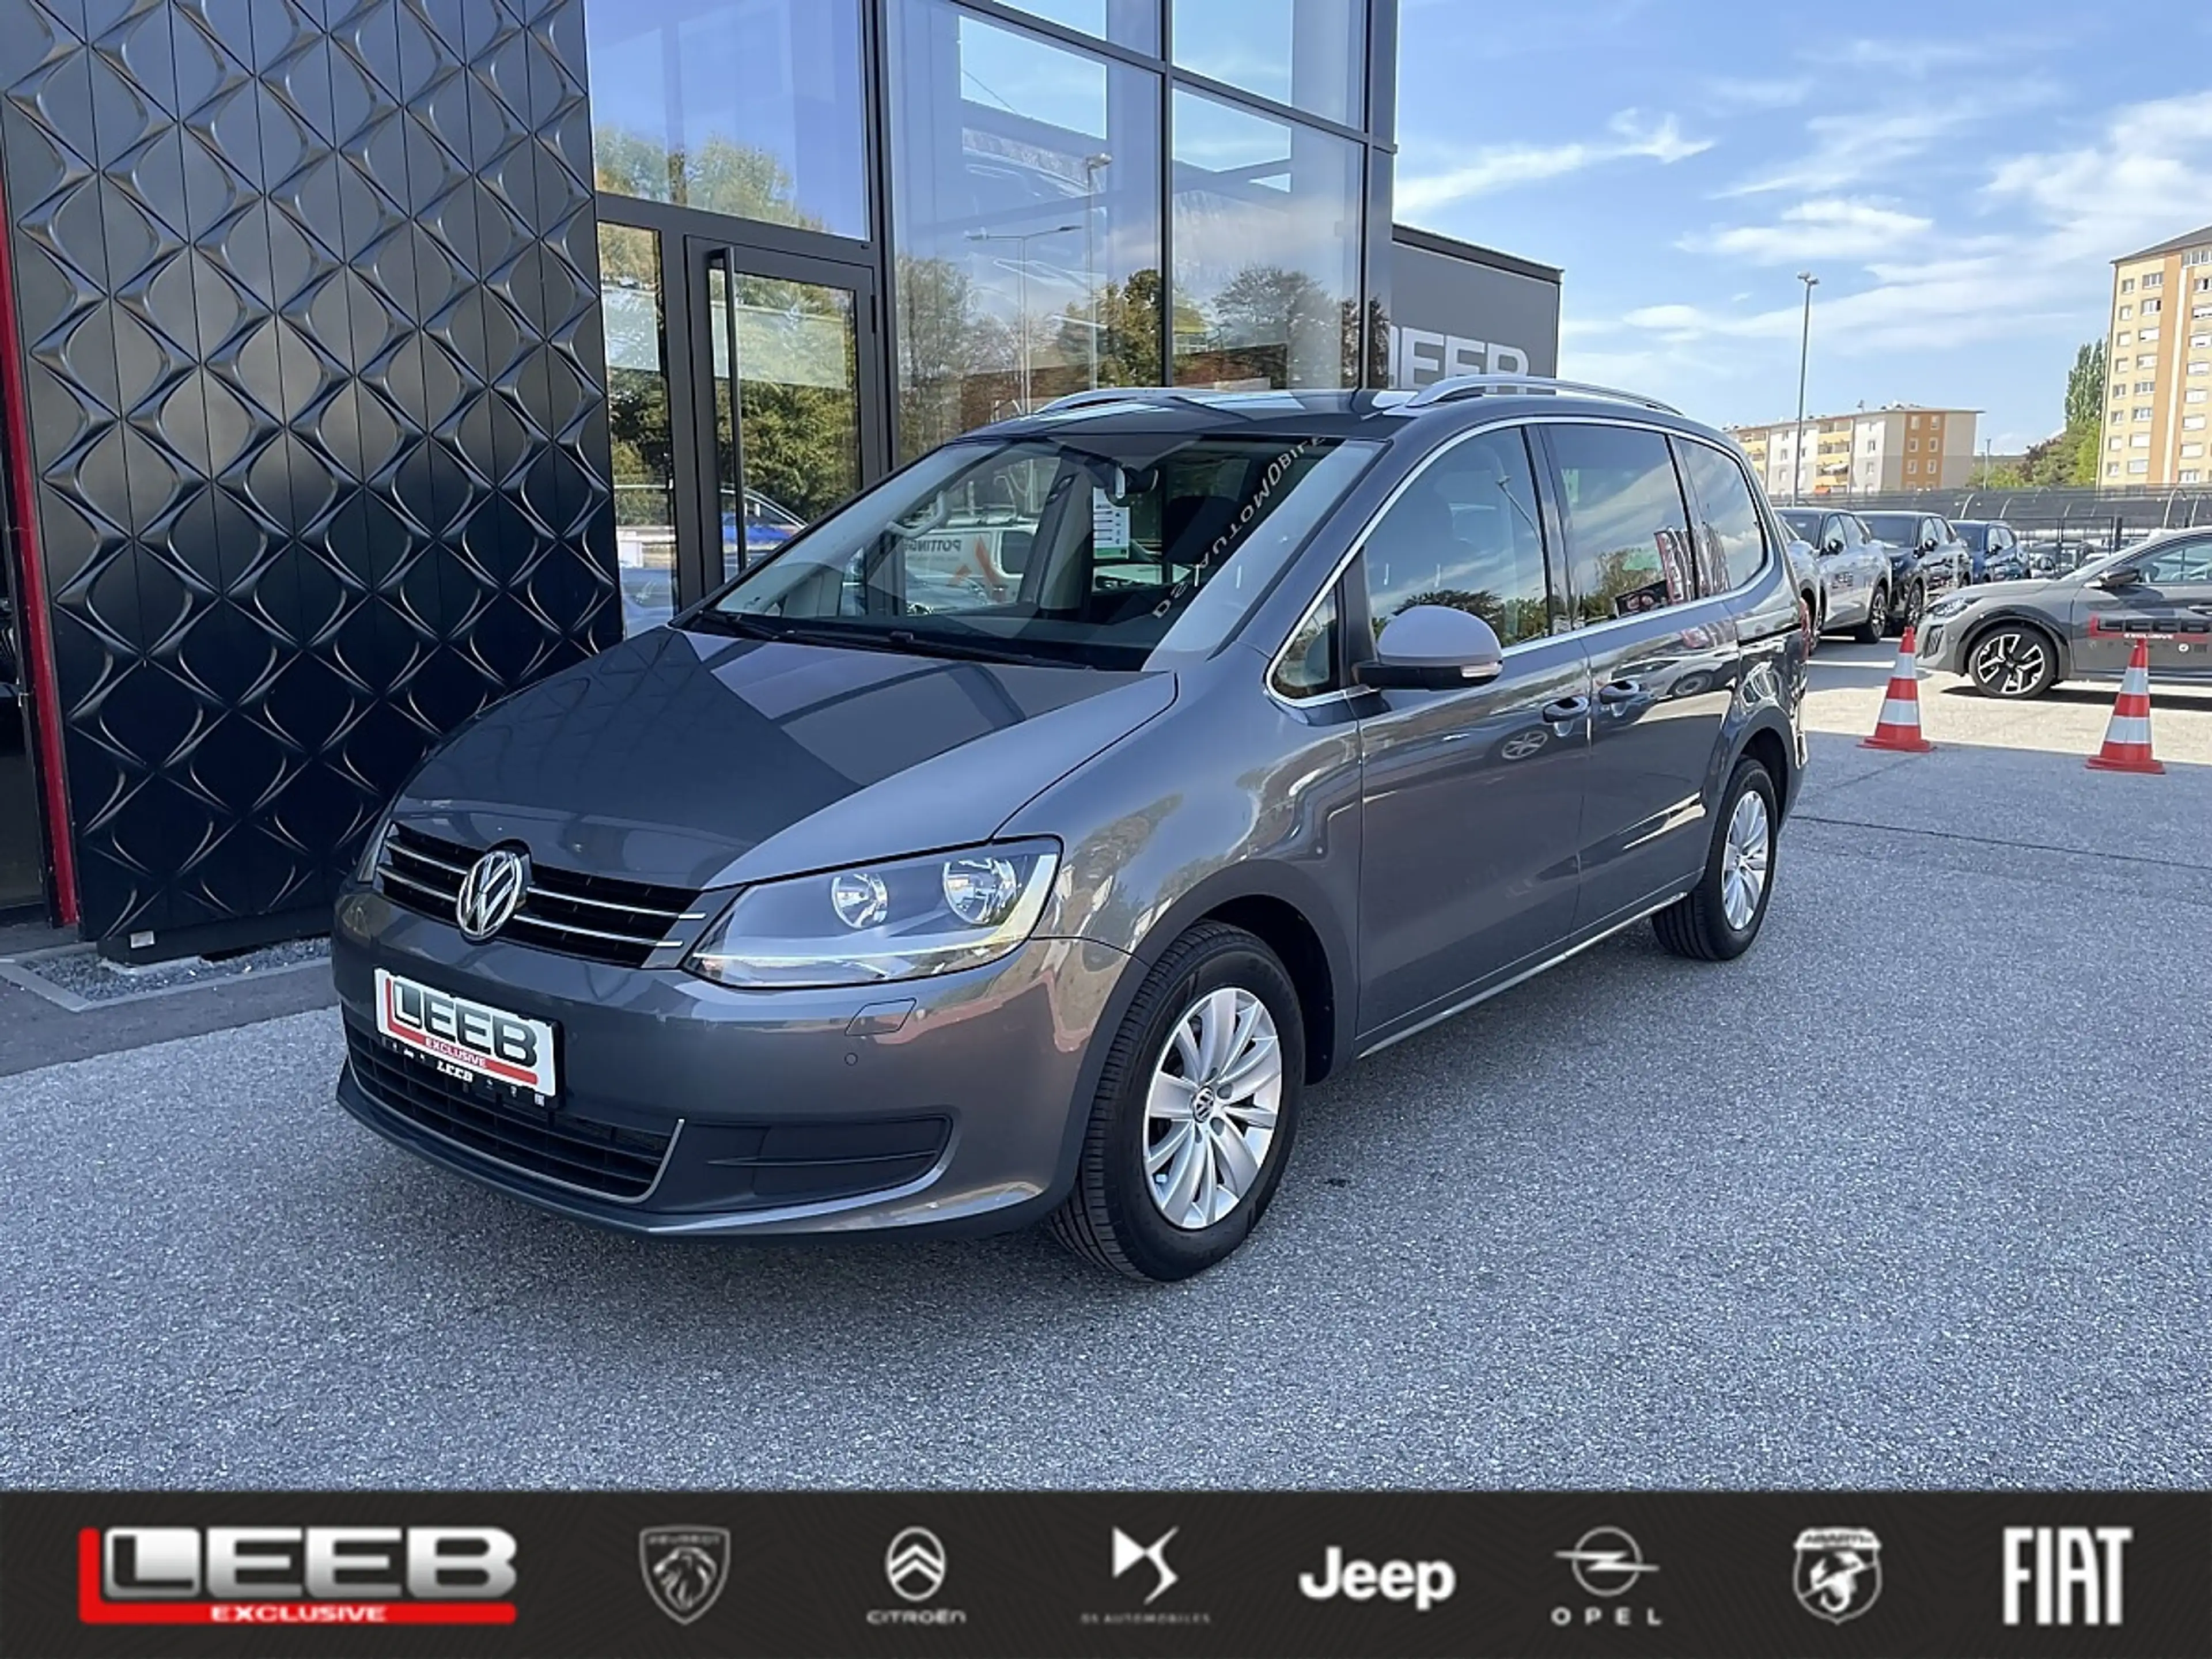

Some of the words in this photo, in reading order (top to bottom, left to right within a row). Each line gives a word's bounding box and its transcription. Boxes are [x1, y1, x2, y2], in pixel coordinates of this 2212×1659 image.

[1389, 324, 1529, 395] EEB
[393, 980, 537, 1067] LEEB
[425, 1037, 487, 1068] EXCLUSIVE
